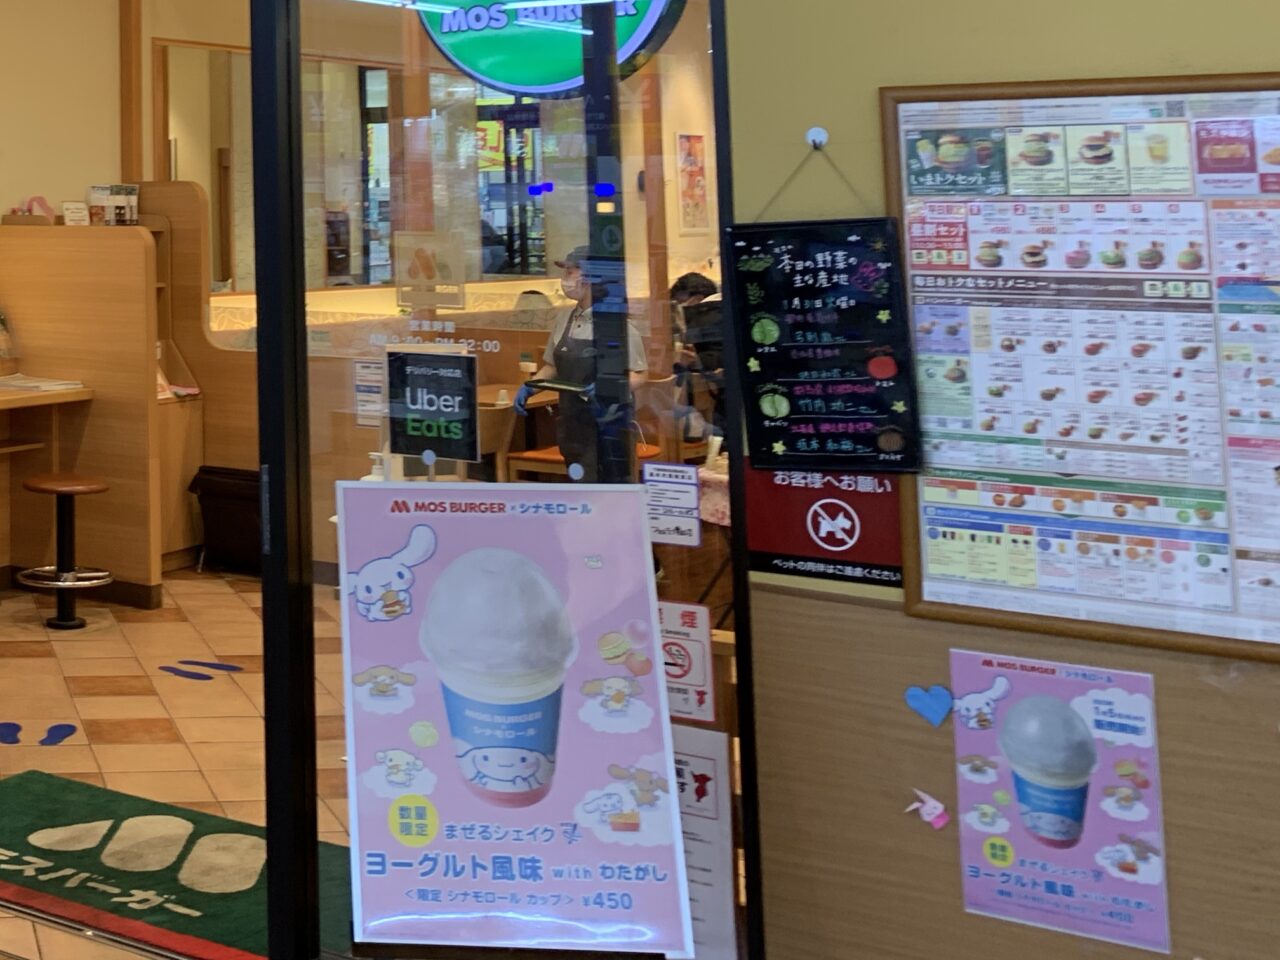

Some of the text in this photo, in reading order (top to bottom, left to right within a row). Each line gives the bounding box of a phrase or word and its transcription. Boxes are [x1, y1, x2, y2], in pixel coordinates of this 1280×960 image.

[440, 2, 509, 34] MOS
[406, 387, 463, 412] Uber
[407, 413, 463, 440] Eats
[774, 471, 892, 493] お客様へお願い
[414, 501, 447, 513] MOS
[449, 502, 506, 514] BURGER
[520, 503, 592, 515] シナモロール
[398, 805, 427, 820] 数量
[399, 821, 429, 838] 限定
[445, 823, 556, 842] まぜるシェイク
[366, 851, 668, 883] ヨーグルト風味 with わたがし
